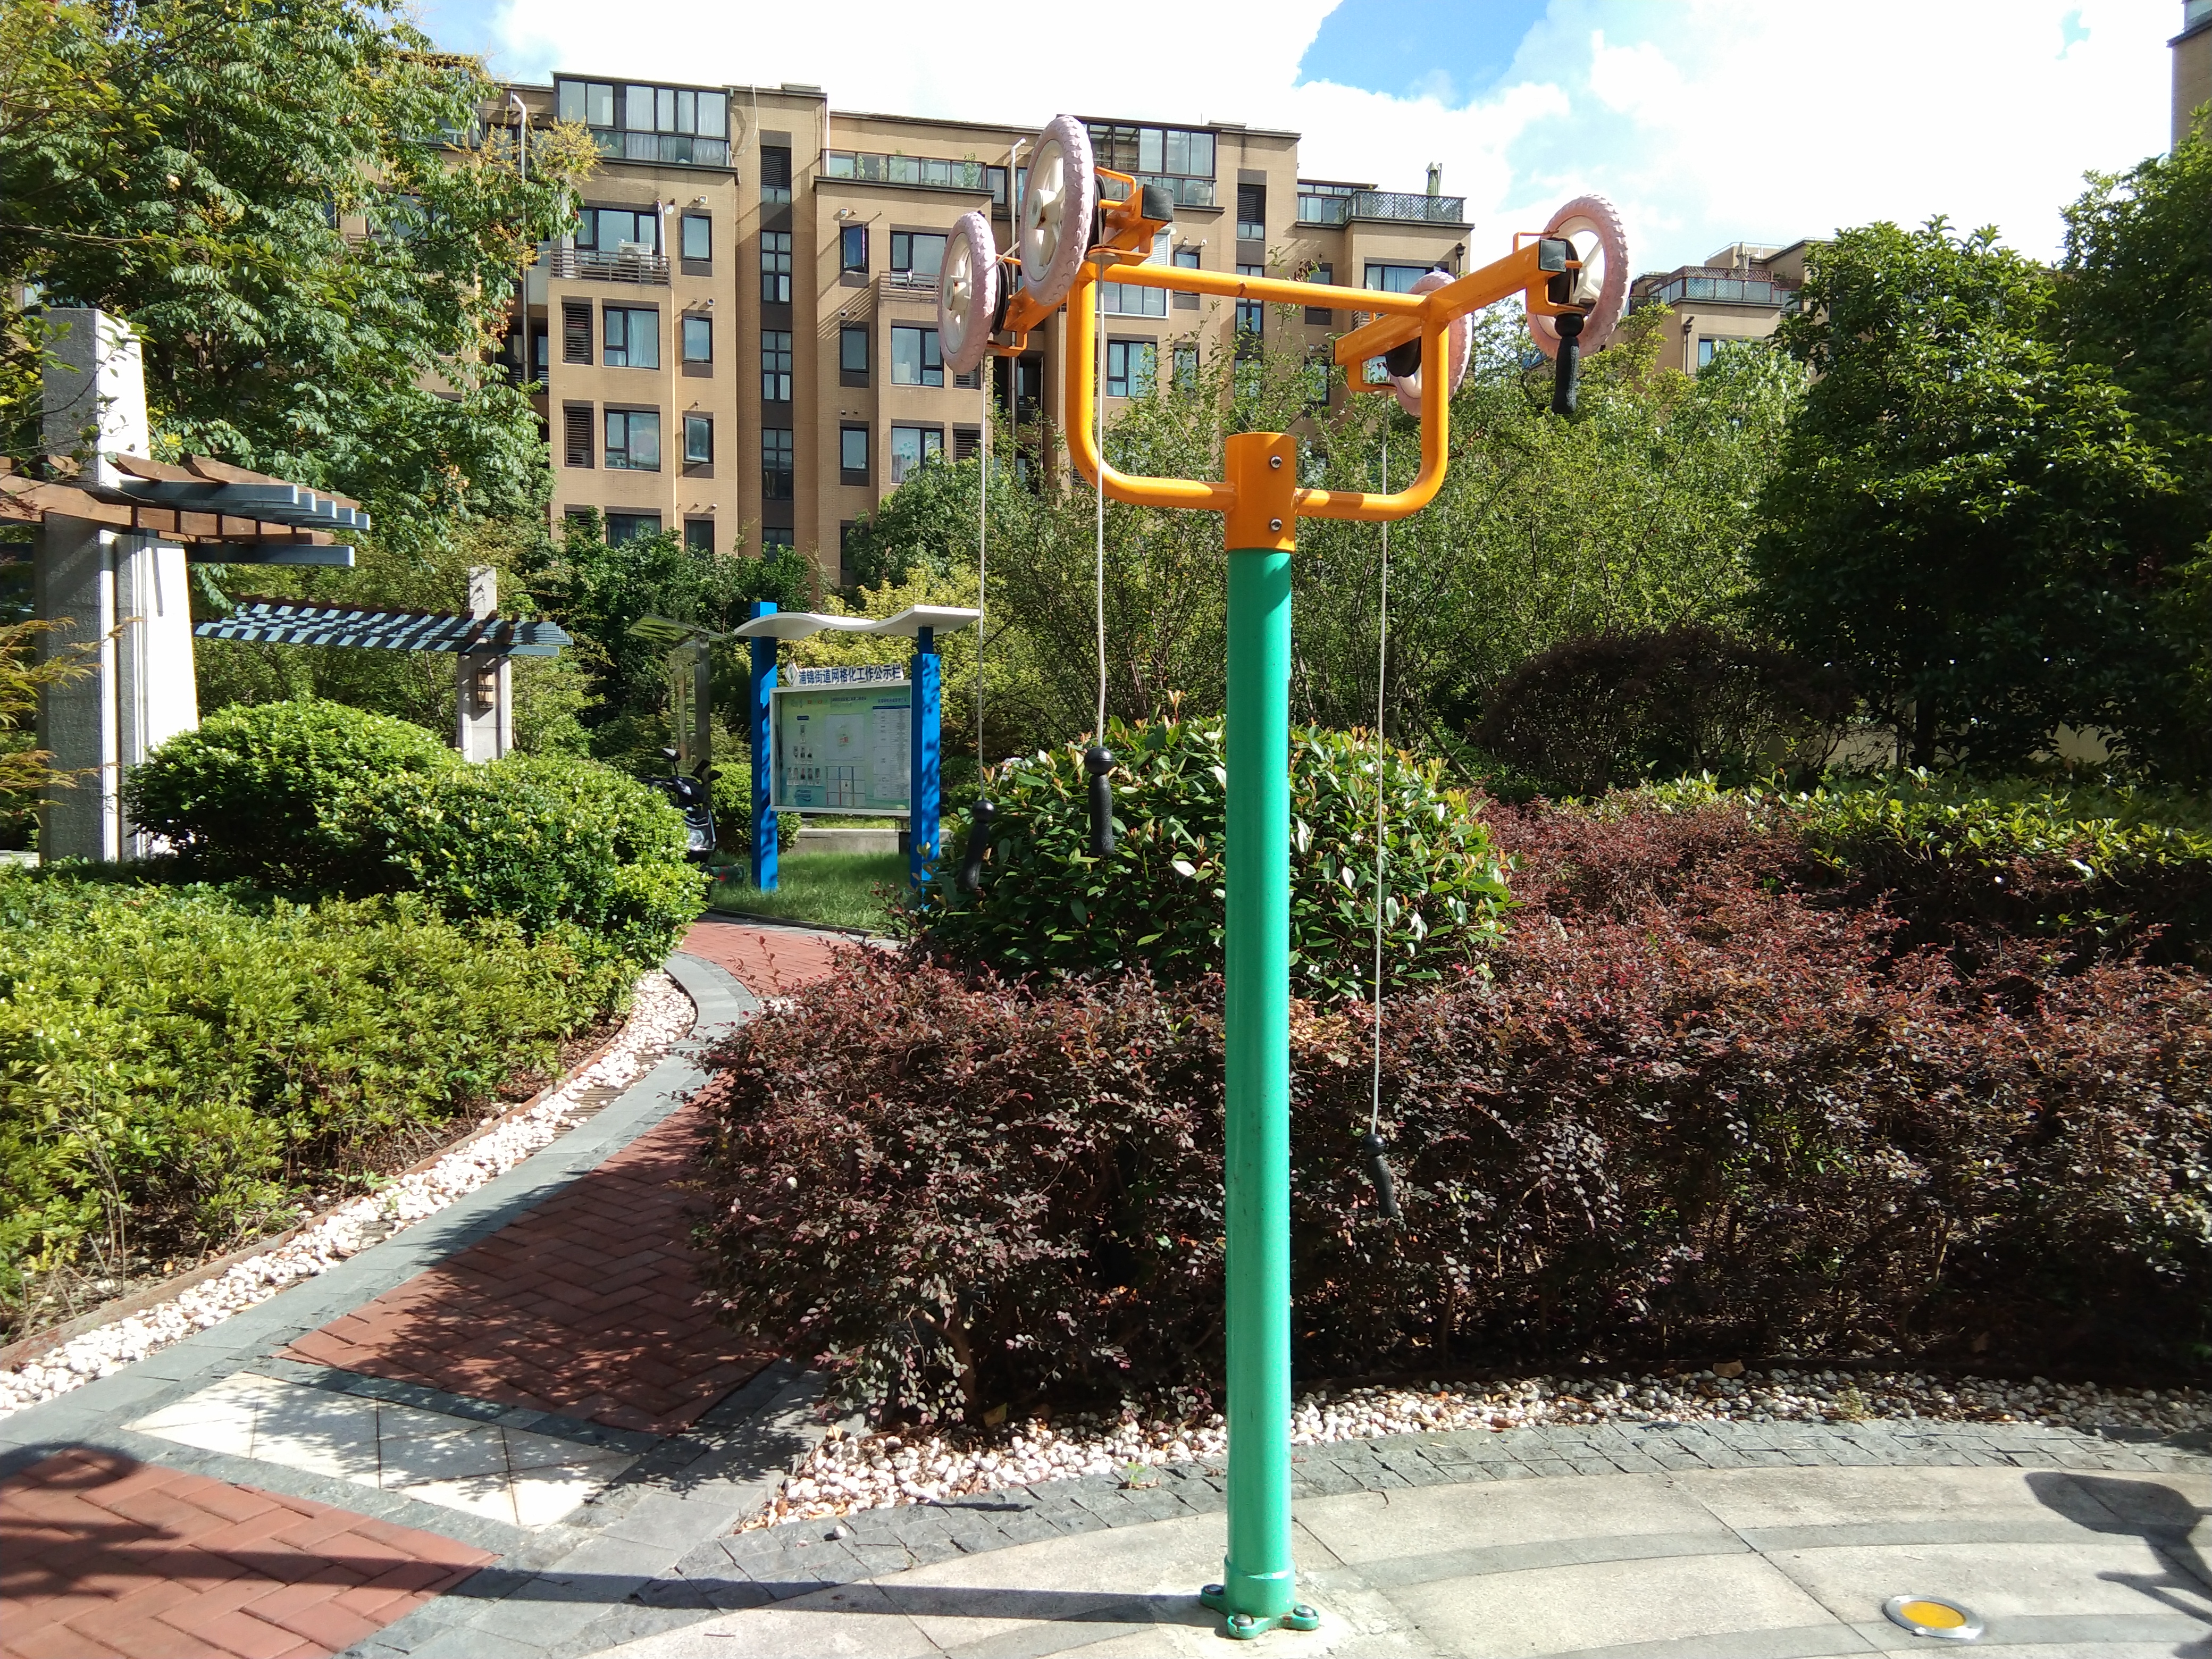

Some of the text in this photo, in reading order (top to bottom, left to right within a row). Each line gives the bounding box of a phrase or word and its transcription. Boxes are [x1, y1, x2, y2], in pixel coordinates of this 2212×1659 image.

[799, 664, 901, 684] 浦锦街道网格化工作公示栏
